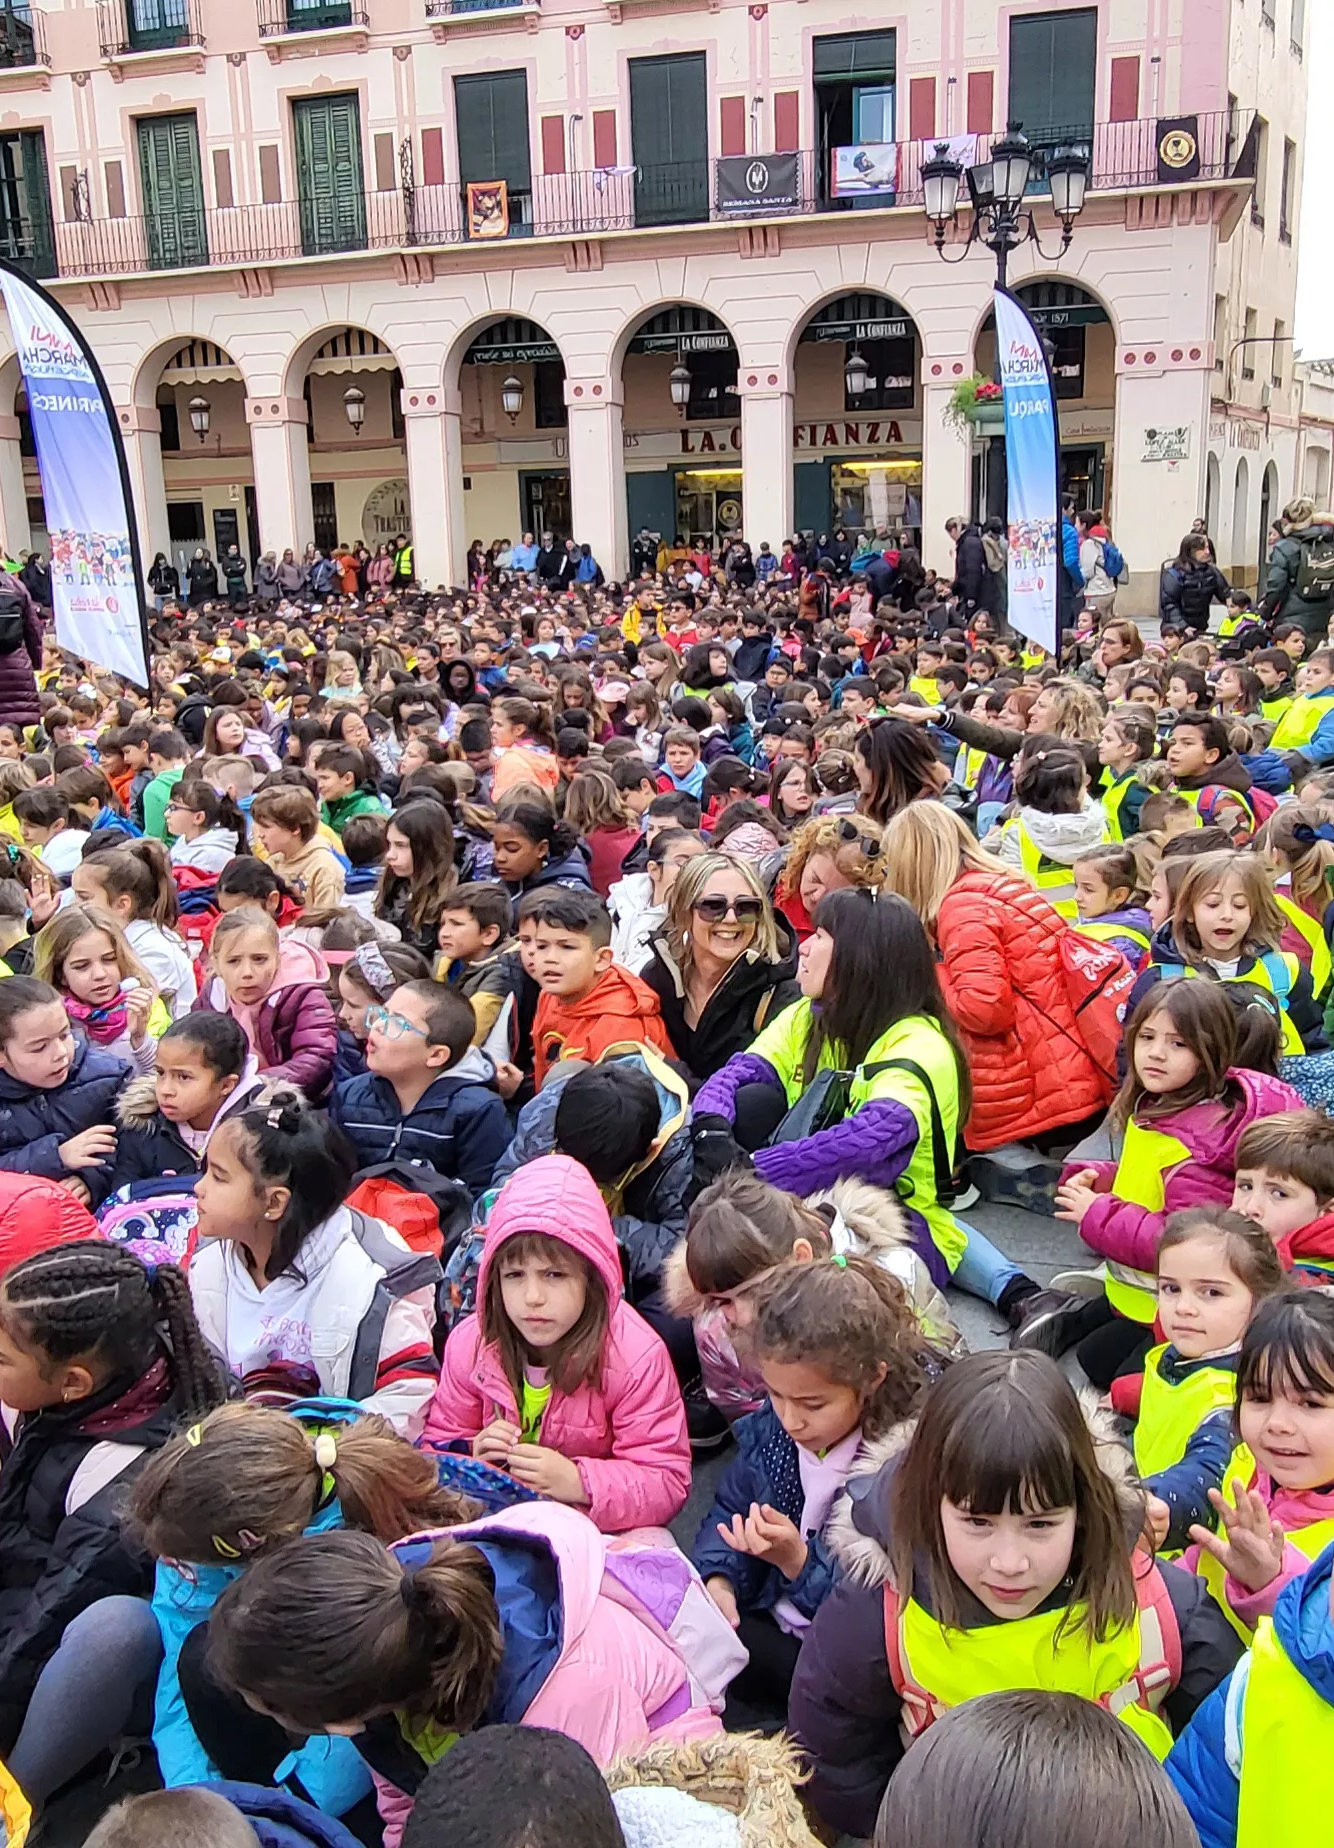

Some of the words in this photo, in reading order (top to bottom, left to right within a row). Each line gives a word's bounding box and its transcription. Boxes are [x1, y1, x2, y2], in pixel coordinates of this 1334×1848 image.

[856, 324, 866, 338] LA
[867, 322, 906, 337] CONFIANZA
[681, 336, 691, 350] LA
[692, 335, 729, 349] CONFIANZA
